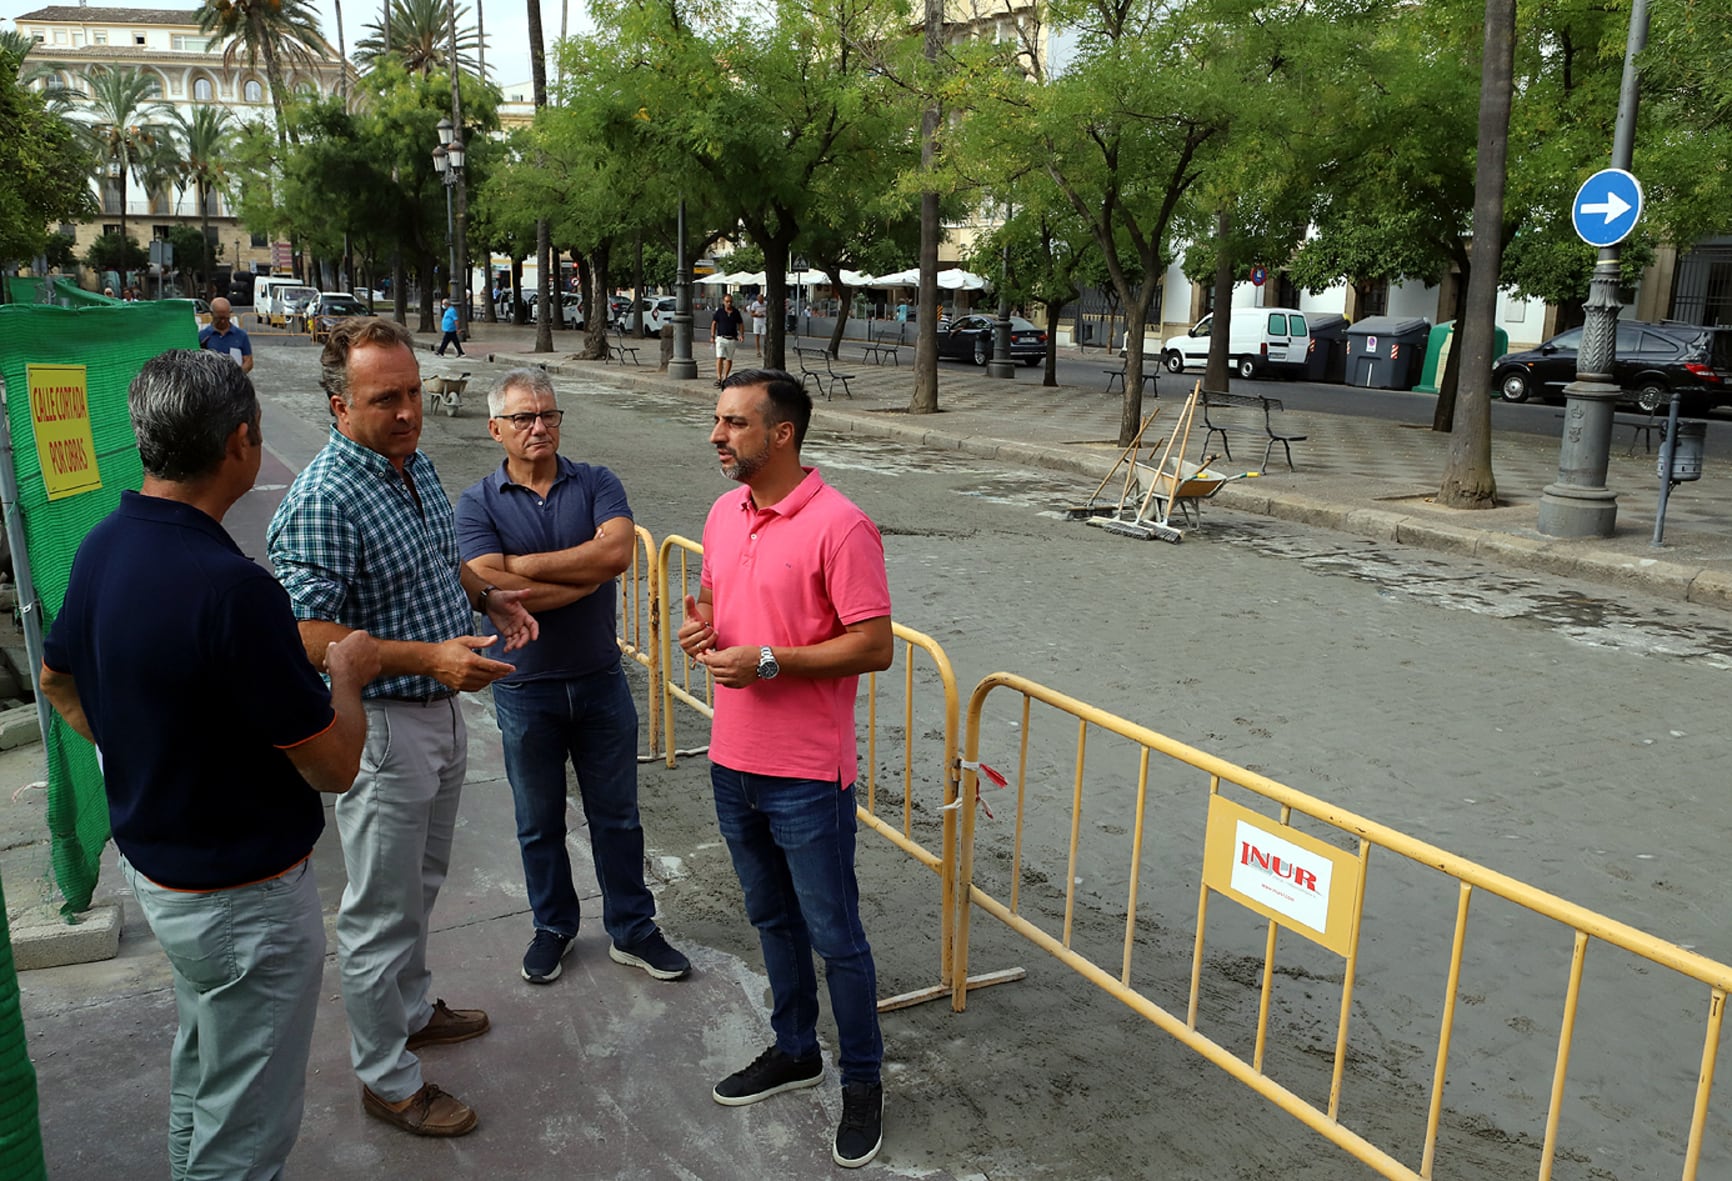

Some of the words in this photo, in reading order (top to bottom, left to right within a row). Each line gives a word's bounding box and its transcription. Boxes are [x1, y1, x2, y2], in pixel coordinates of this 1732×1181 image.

[33, 386, 57, 423] CALLE
[55, 386, 87, 421] CORTADA
[49, 440, 66, 475] POR
[64, 438, 88, 473] OBRAS
[1240, 841, 1317, 892] INUR
